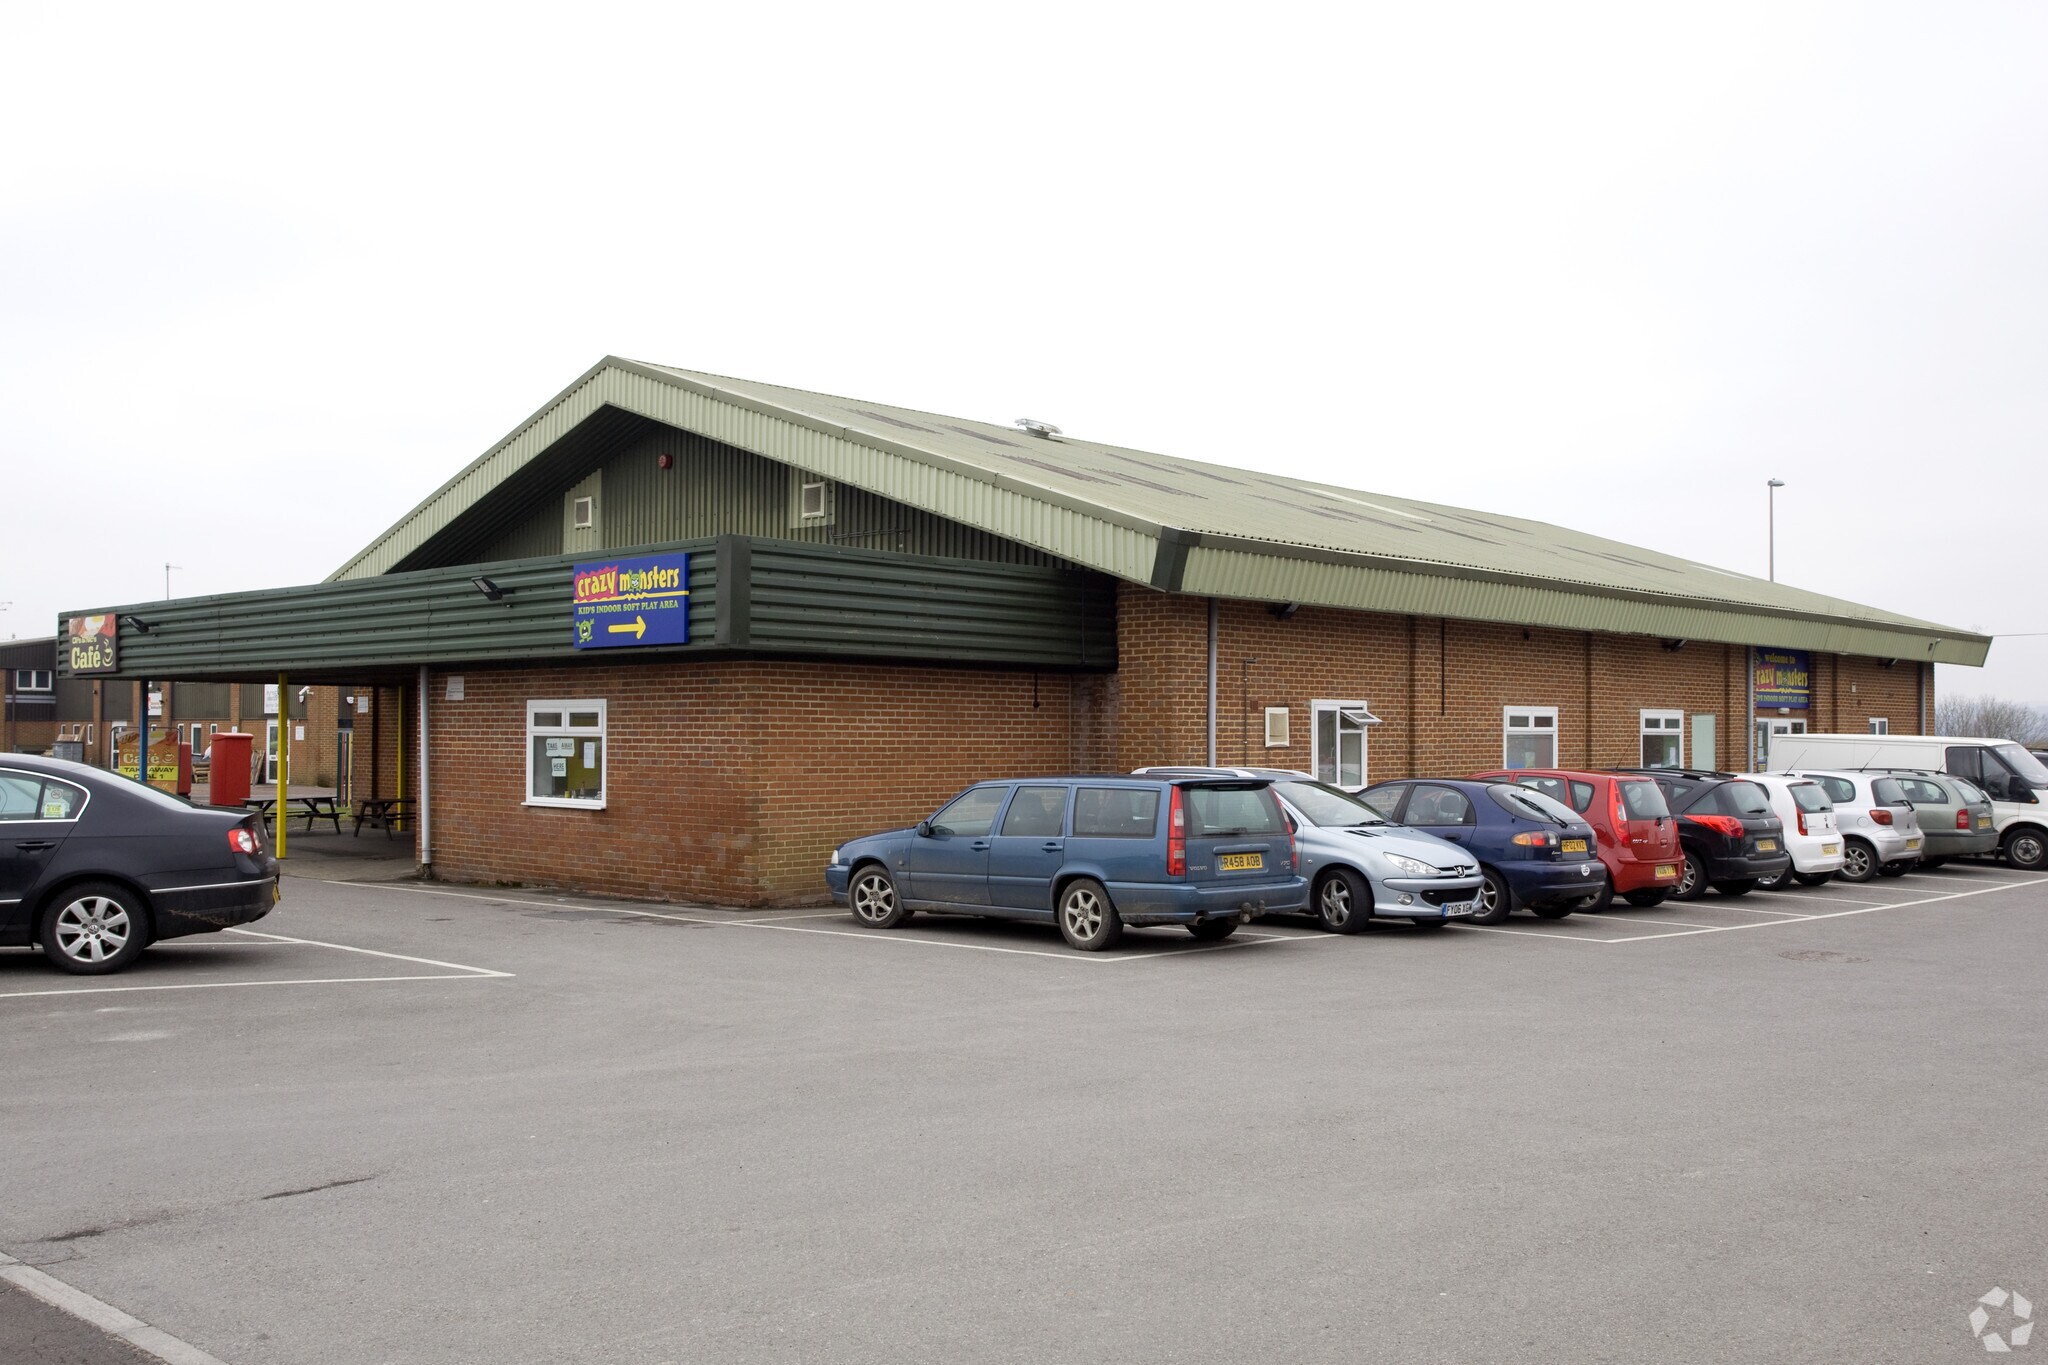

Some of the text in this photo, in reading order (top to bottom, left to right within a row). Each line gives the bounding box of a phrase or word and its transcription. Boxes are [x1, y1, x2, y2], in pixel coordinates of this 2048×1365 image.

[578, 571, 616, 597] crazy
[578, 600, 679, 615] KID'S INDOOR SOFT PLAY AREA
[72, 645, 100, 669] Café
[1765, 653, 1795, 664] welcome to
[1756, 667, 1774, 686] razy
[123, 753, 159, 764] Caé
[1223, 855, 1261, 868] R458 AOB
[1447, 904, 1462, 914] FY06
